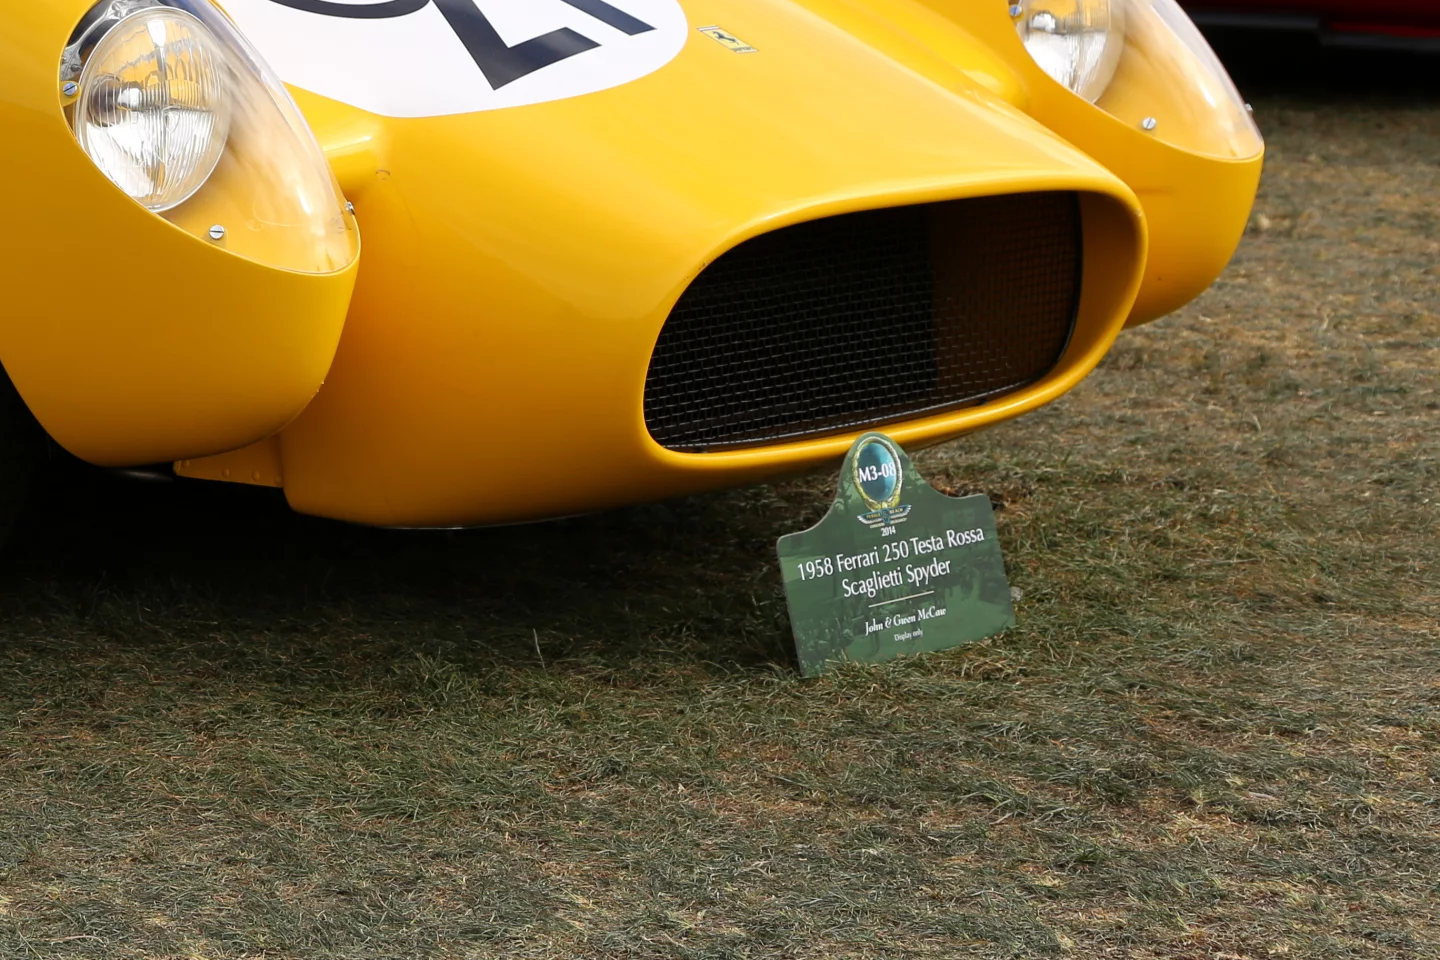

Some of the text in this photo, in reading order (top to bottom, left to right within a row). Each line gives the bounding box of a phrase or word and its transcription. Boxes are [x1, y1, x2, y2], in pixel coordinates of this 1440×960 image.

[859, 462, 897, 483] M3-08
[880, 525, 896, 537] 2014
[797, 527, 985, 580] 1958 Ferrari 250 Testa Rossa
[842, 559, 951, 598] Scaglietti Spyder
[865, 606, 946, 636] John & Gwen McCaw
